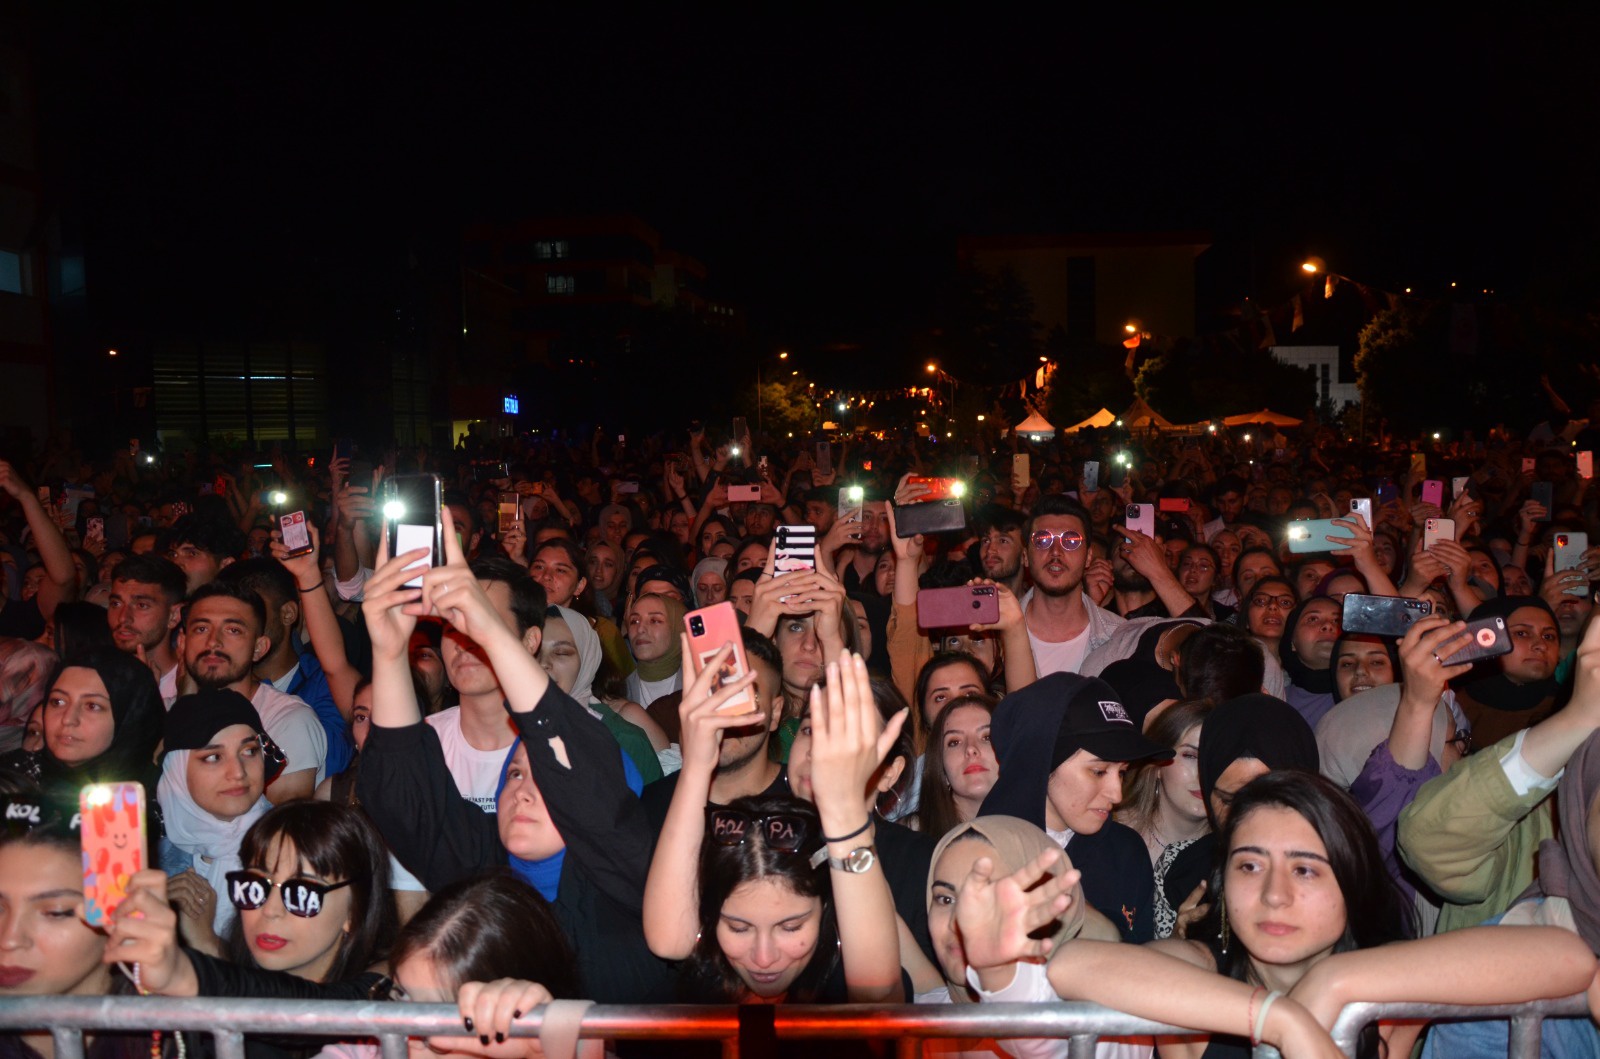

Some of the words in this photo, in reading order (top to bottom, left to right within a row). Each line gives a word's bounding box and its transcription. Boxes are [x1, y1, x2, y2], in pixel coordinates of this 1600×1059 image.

[6, 803, 40, 823] KOL
[714, 817, 744, 835] KOL
[770, 821, 794, 839] PA
[234, 880, 265, 905] KO
[284, 885, 320, 914] LPA
